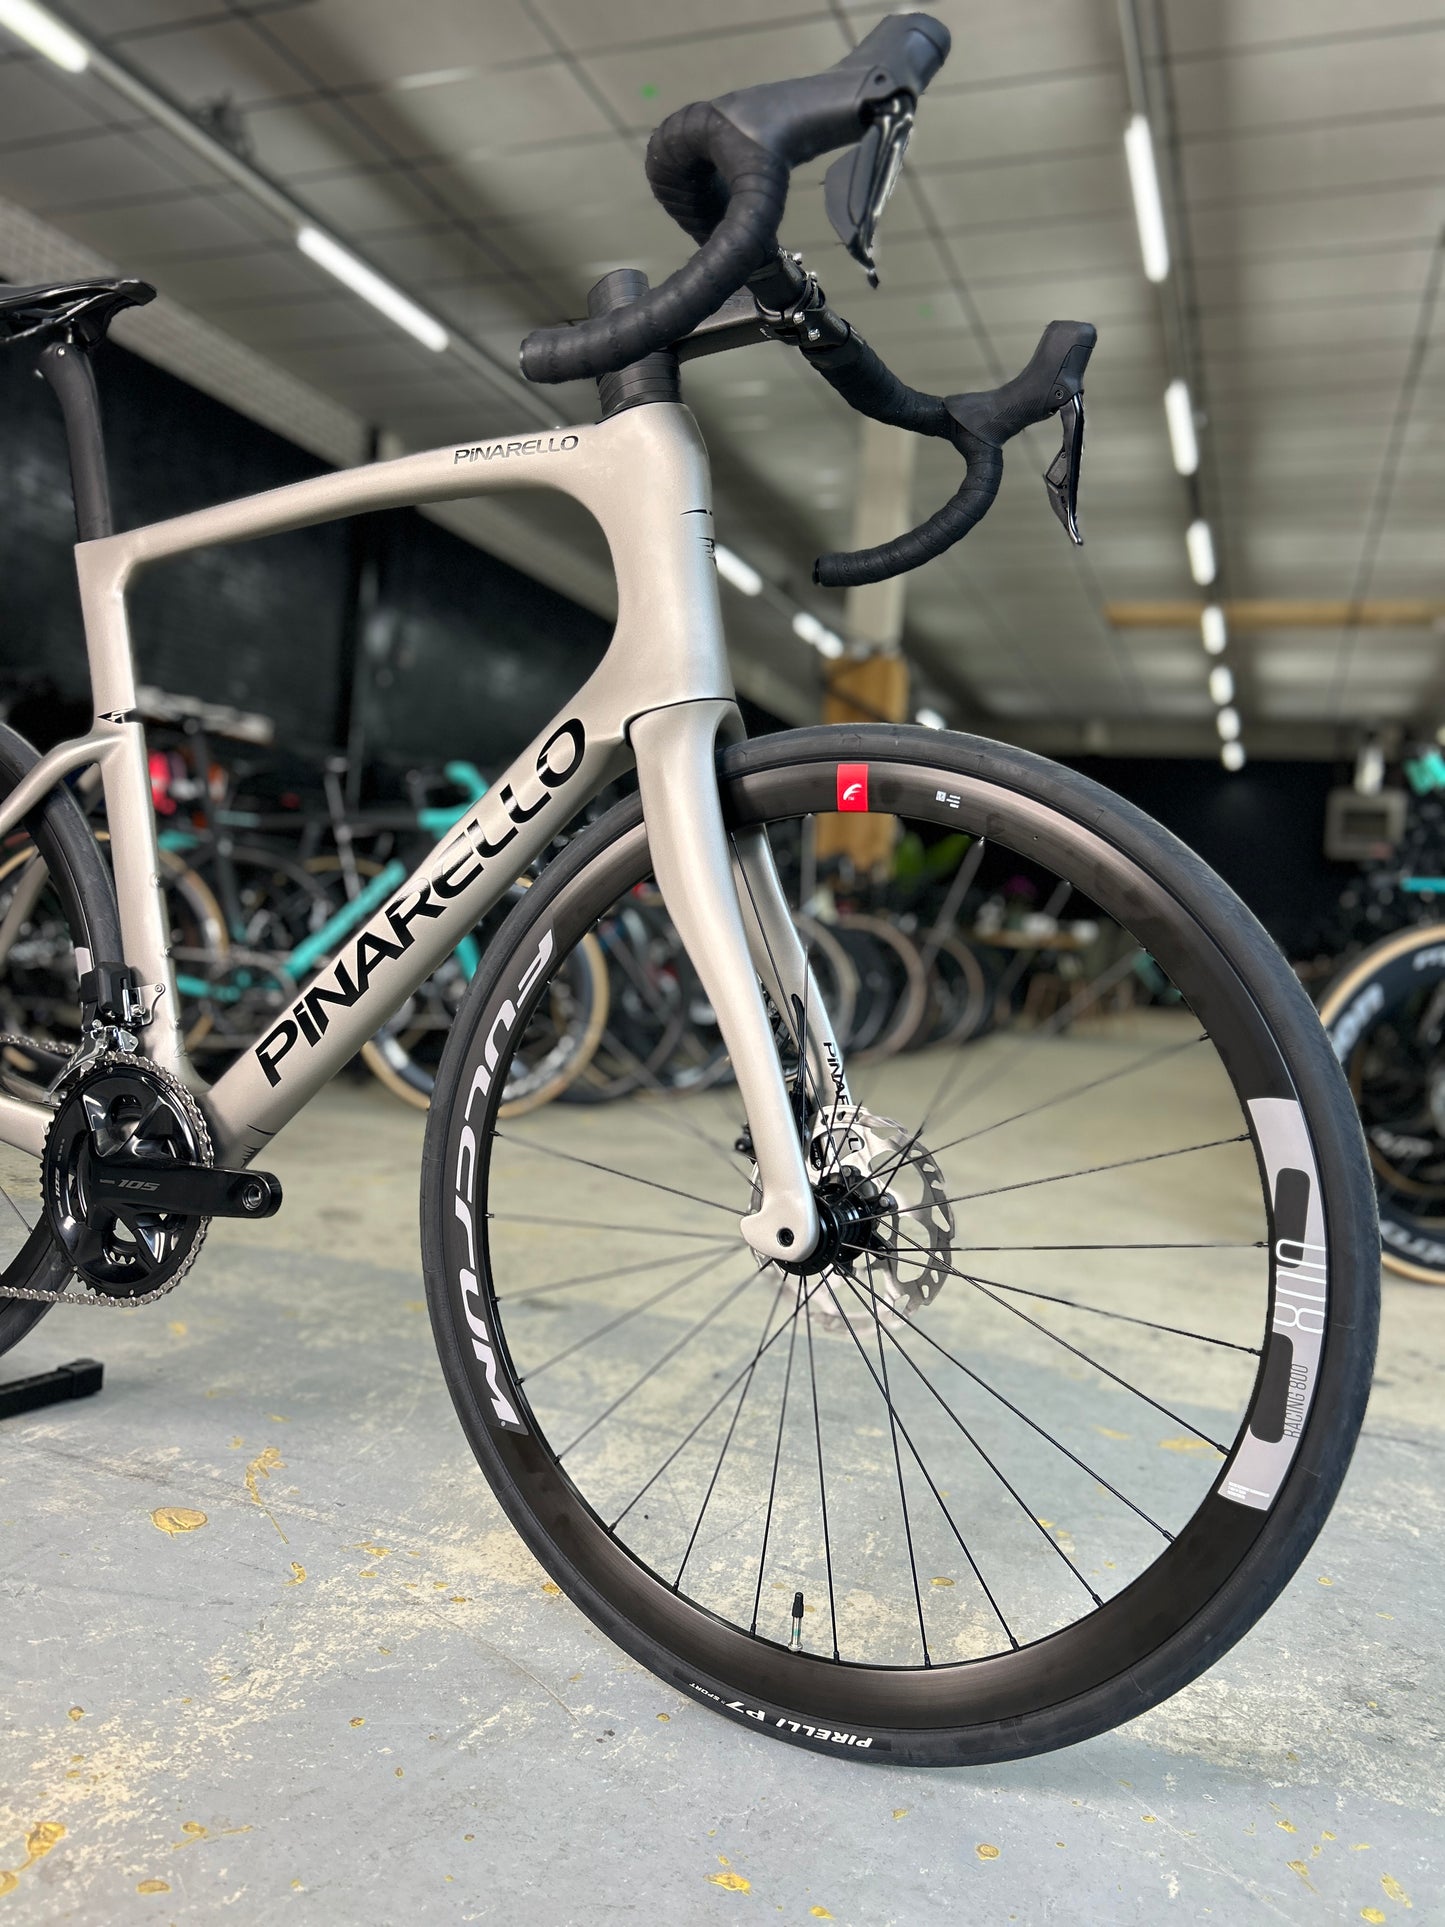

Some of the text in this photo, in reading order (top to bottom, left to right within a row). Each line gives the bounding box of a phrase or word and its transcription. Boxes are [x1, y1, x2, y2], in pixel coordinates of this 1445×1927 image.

[118, 1180, 160, 1192] 105
[1284, 1364, 1308, 1439] RACING 800
[689, 1682, 873, 1748] PIRELLI P7 SPORT
